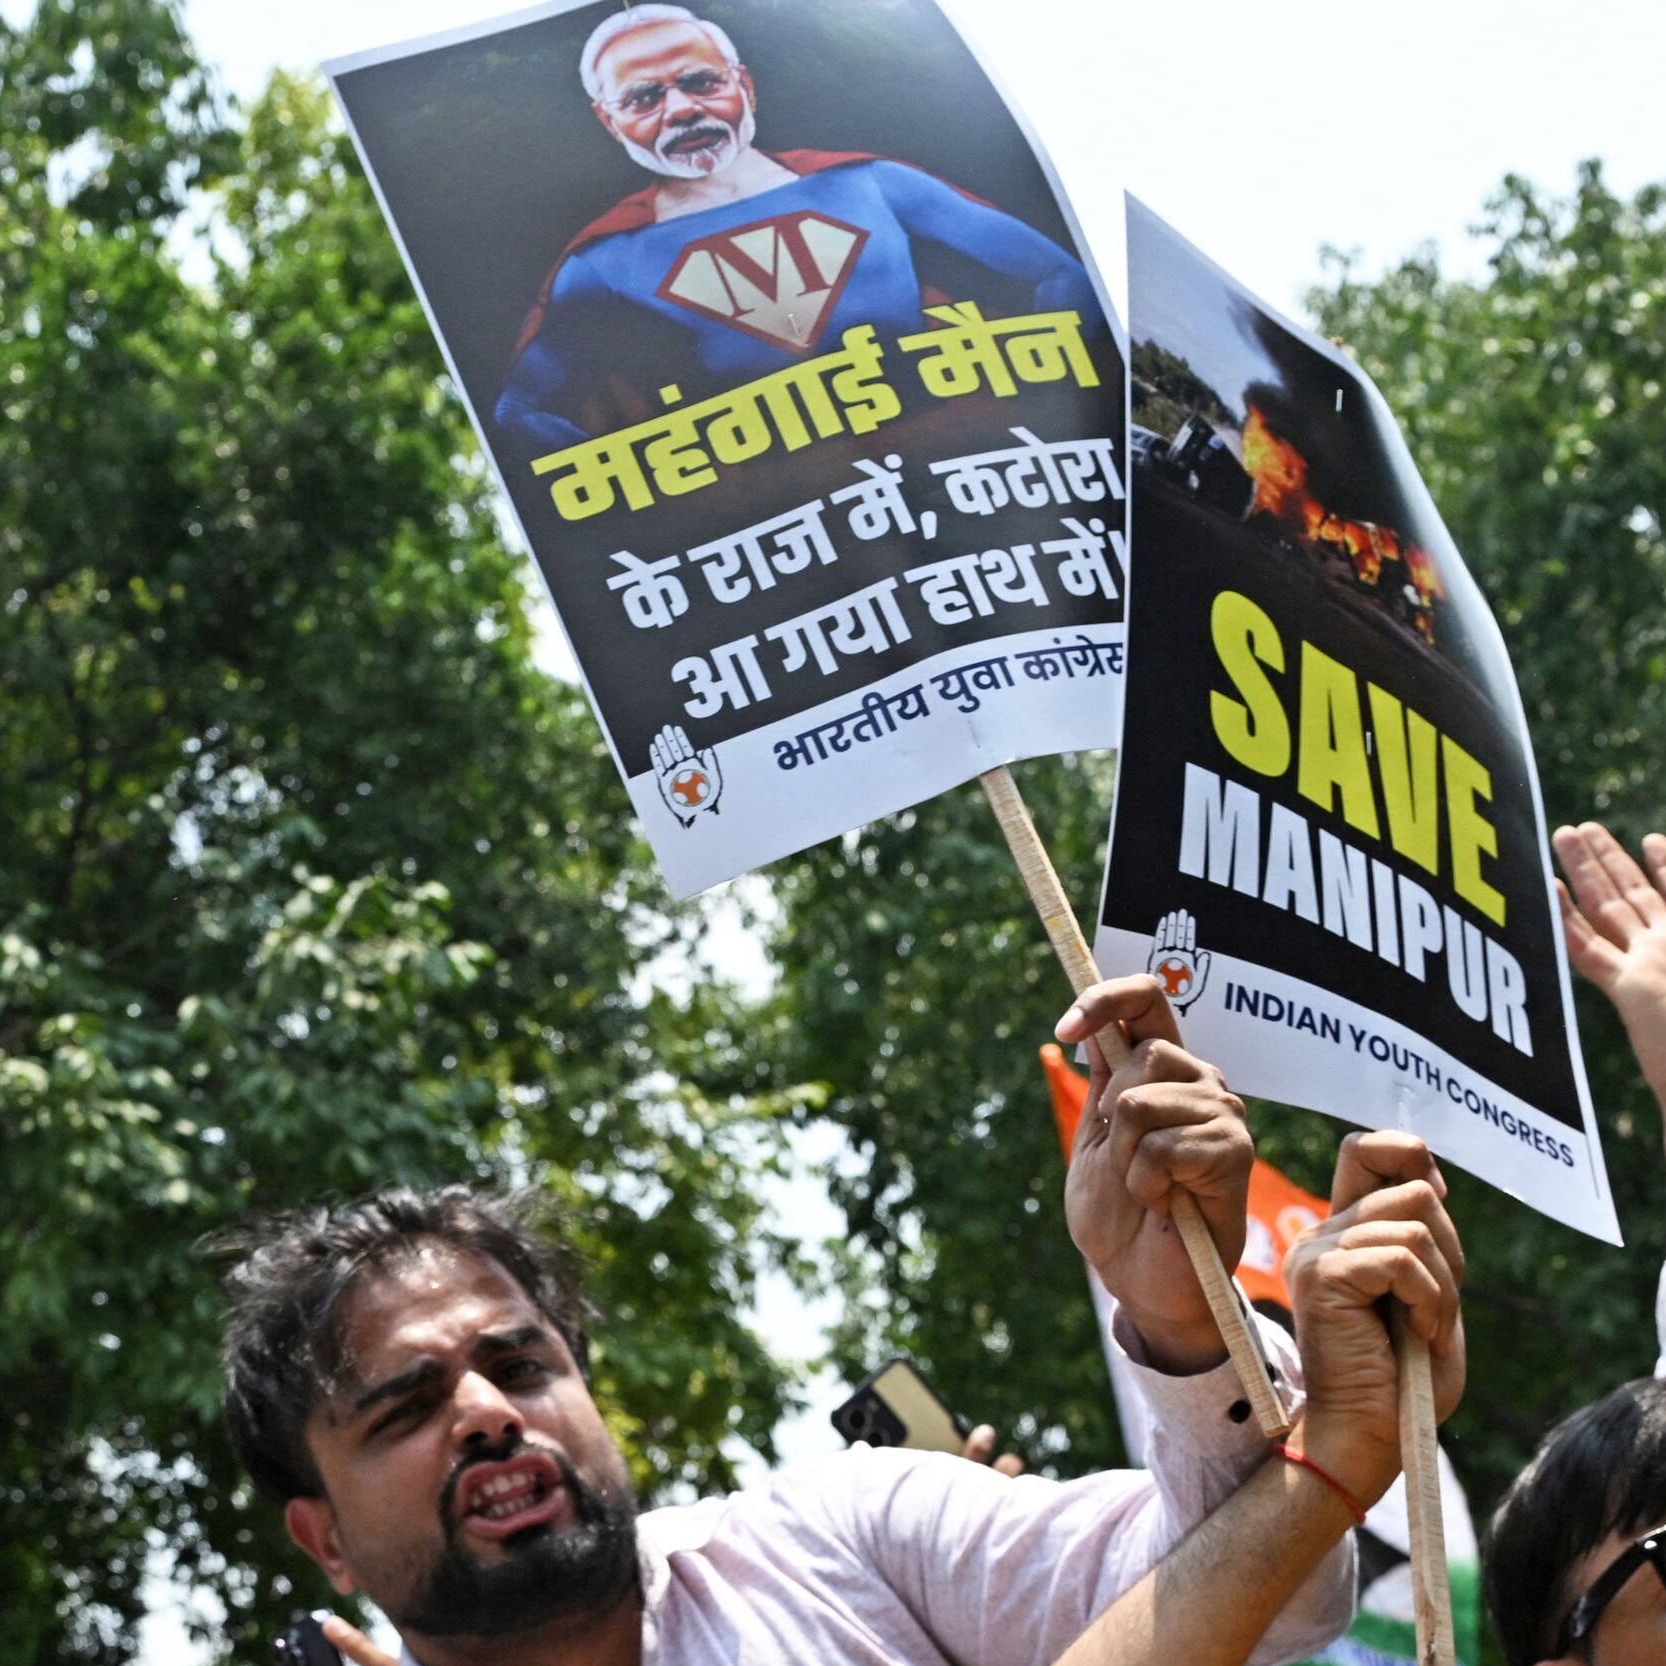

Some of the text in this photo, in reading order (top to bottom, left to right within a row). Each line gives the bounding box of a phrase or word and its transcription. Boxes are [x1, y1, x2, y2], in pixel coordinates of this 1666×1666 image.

[531, 301, 1100, 521] महंगाई मैन
[607, 426, 1125, 629] के राज में, कटोरा
[671, 634, 773, 720] आ
[765, 577, 912, 676] गया
[904, 547, 1050, 625] हाथ
[773, 689, 931, 772] भारतीय
[930, 655, 1014, 713] युवा
[1210, 590, 1506, 928] SAVE
[1178, 762, 1534, 1058] MANIPUR
[1224, 982, 1575, 1168] INDIAN YOUTH CONGRESS
